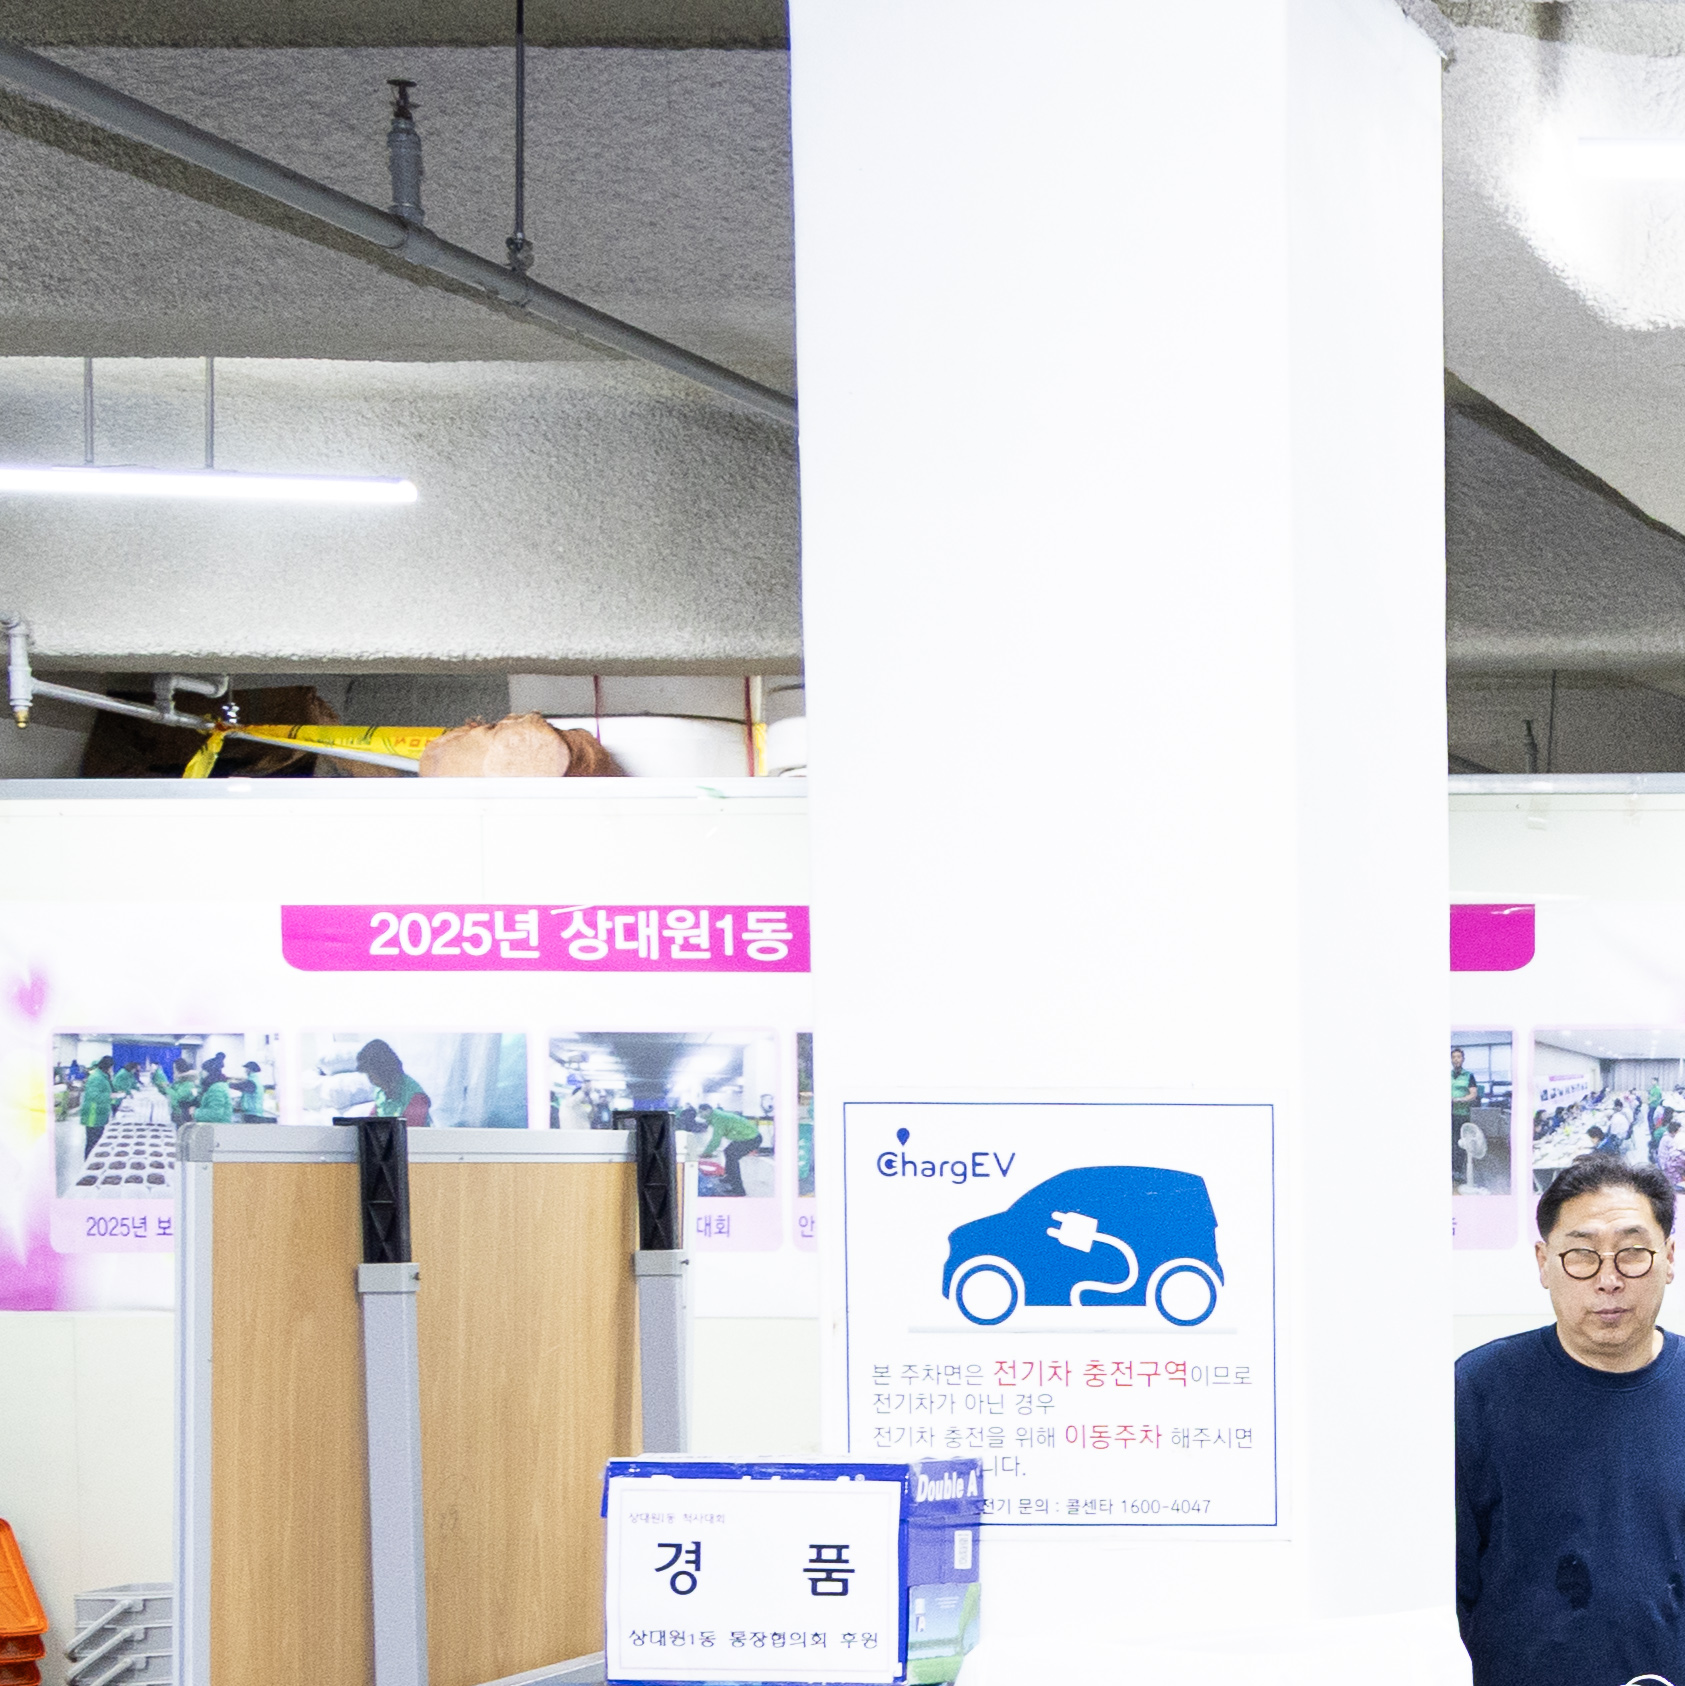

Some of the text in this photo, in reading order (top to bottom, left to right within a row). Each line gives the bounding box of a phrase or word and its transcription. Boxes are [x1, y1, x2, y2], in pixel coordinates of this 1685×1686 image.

[369, 909, 794, 962] 2025년 상대원1동
[877, 1152, 1016, 1184] ChargEV
[86, 1215, 147, 1238] 2025년
[696, 1214, 730, 1237] 대회
[872, 1364, 892, 1387] 본
[901, 1364, 985, 1387] 주차면은
[993, 1360, 1072, 1388] 전기차
[873, 1393, 1056, 1417] 전기차가 아닌 경우
[873, 1424, 1253, 1450] 전기차 충전을 위해 이동주차 해주시면
[916, 1469, 979, 1503] Double A
[1018, 1498, 1049, 1515] 문의
[1066, 1498, 1114, 1515] 콜센타
[1121, 1499, 1211, 1515] 1600-4047
[654, 1540, 856, 1597] 경 품
[628, 1629, 879, 1650] 상대원1동 통장협의회 후원
